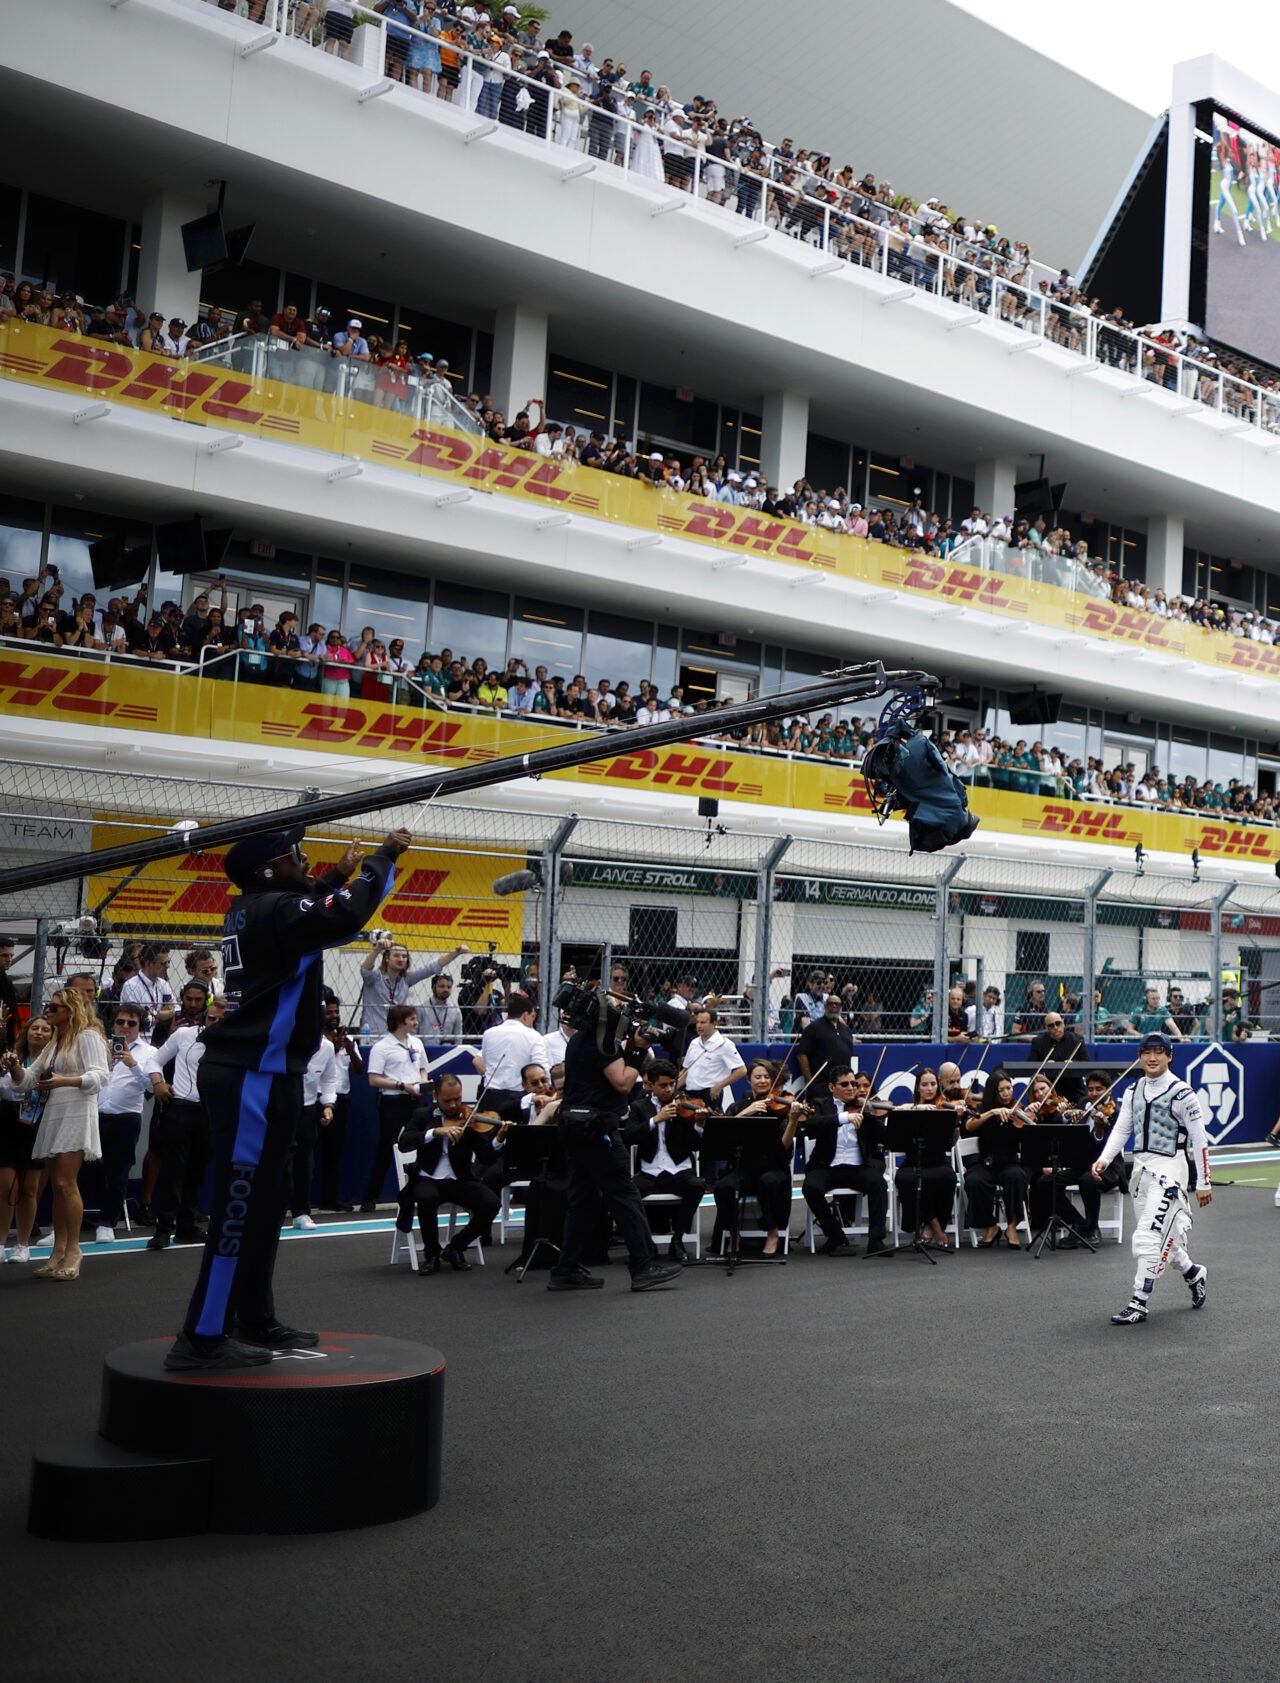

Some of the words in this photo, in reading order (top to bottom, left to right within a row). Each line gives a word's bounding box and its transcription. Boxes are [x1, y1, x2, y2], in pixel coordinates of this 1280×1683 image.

[43, 339, 262, 424] DHL
[407, 429, 571, 502] DHL
[684, 502, 813, 562] DHL
[904, 559, 1006, 606] DHL
[1082, 602, 1169, 647] DHL
[296, 702, 470, 759] DHL
[605, 750, 740, 793] DHL
[9, 823, 74, 840] TEAM
[1040, 803, 1127, 841] DHL
[1196, 826, 1273, 858] DHL
[592, 867, 643, 883] LANCE
[645, 871, 698, 888] STROLL
[803, 880, 821, 899] 14
[829, 887, 898, 903] FERNANDO
[898, 890, 937, 905] ALONS
[217, 1164, 257, 1256] FOCUS
